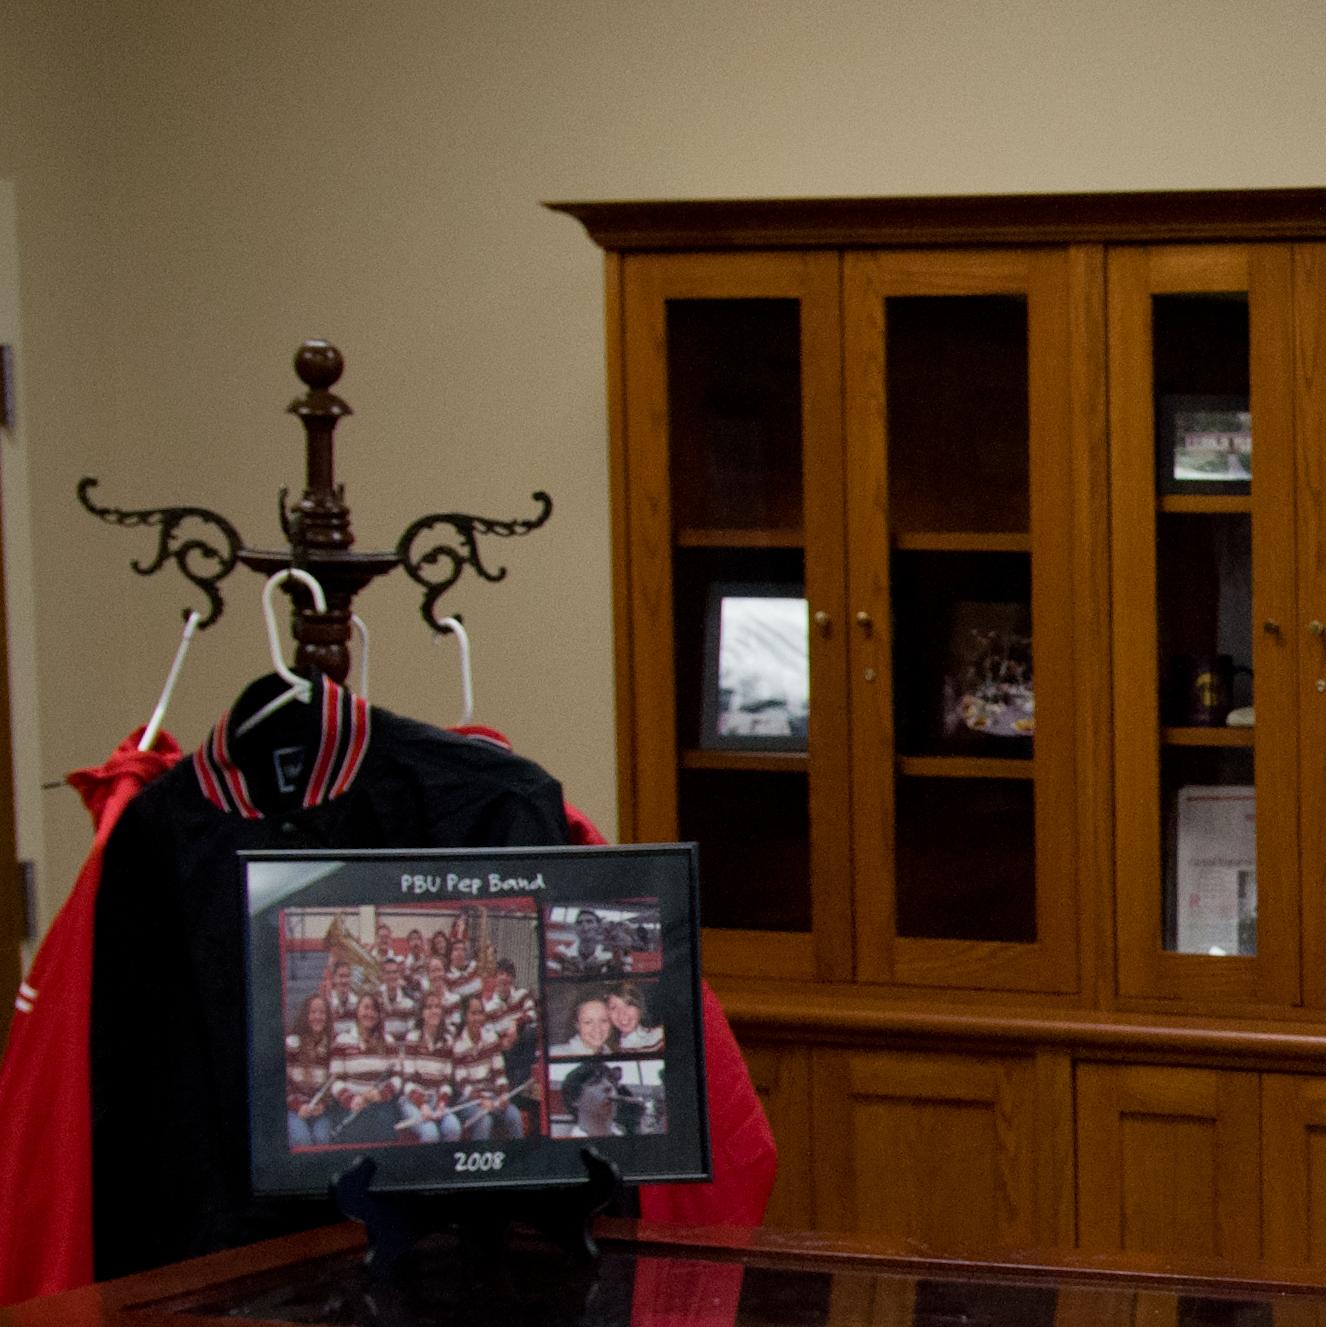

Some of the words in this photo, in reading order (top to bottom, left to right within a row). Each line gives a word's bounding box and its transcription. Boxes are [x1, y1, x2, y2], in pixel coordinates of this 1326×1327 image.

[401, 873, 441, 893] PBU
[446, 874, 482, 896] Pep
[489, 872, 546, 892] Band
[453, 1150, 506, 1173] 2008
